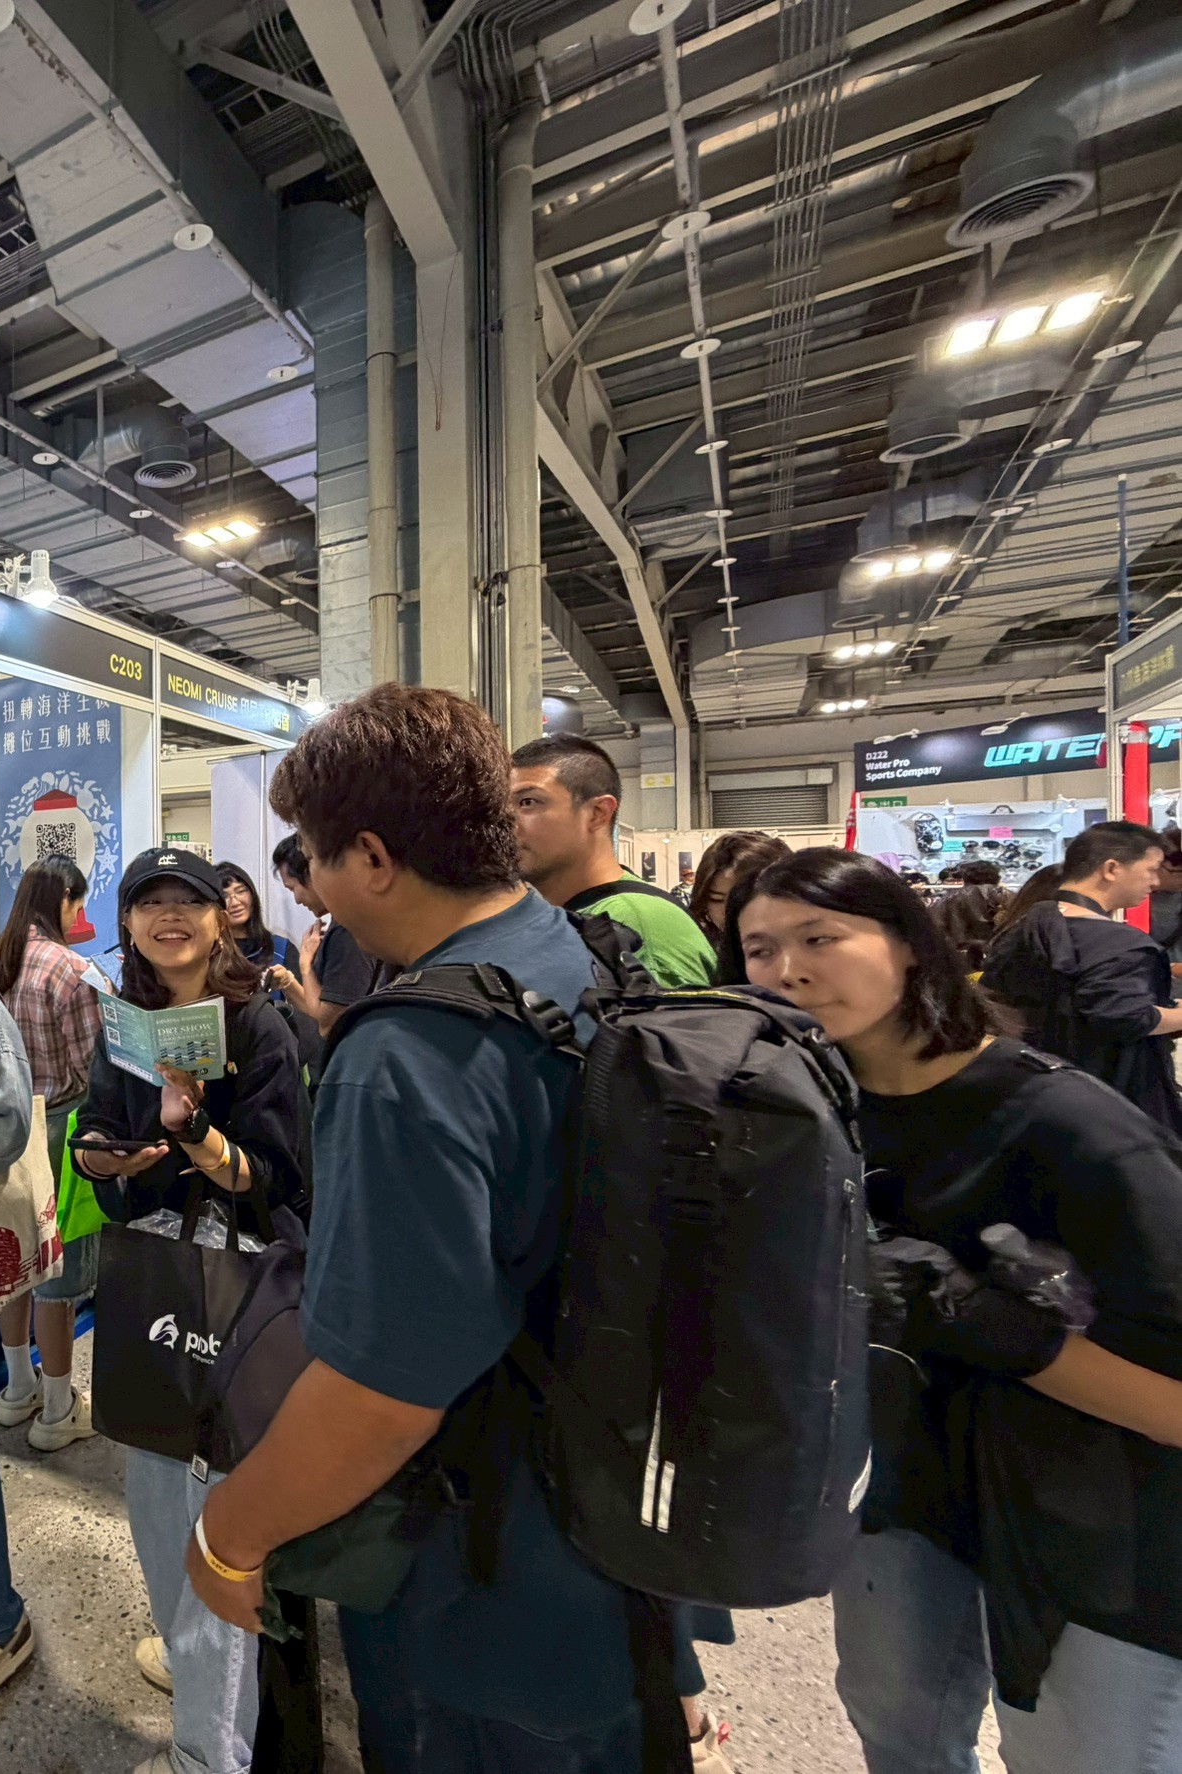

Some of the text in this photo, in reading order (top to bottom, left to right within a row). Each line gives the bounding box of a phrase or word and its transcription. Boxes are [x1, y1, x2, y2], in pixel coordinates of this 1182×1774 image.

[110, 654, 143, 682] C203
[168, 673, 202, 701] NEOMI
[205, 688, 238, 713] CRUISE
[3, 719, 111, 755] 攤位互動挑戰
[984, 732, 1106, 768] WATE
[865, 758, 910, 771] Water Pro
[866, 750, 888, 760] D222
[865, 765, 942, 782] Sports Company
